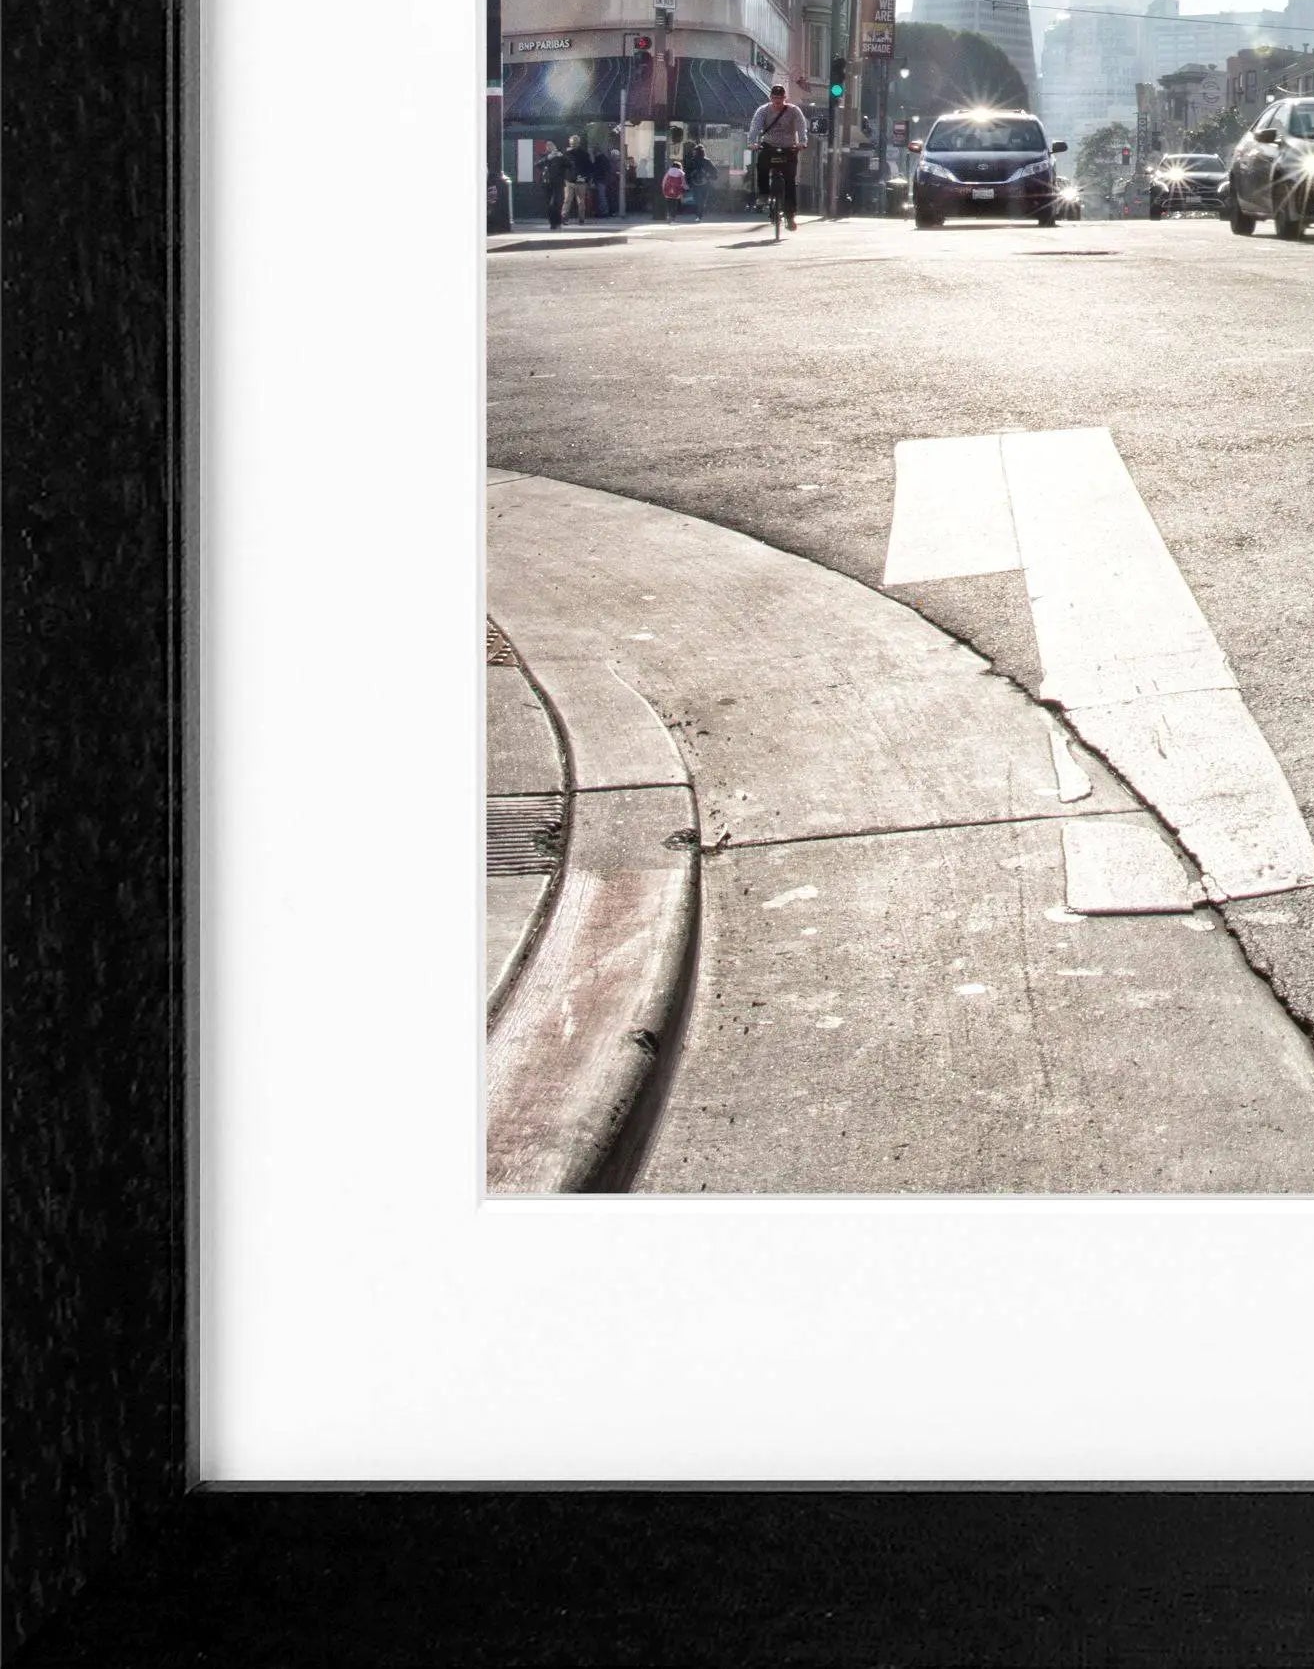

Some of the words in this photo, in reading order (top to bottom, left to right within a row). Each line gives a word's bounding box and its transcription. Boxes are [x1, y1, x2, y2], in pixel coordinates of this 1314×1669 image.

[875, 10, 893, 21] ARE
[518, 42, 535, 51] BNP
[536, 39, 570, 50] PARIBAS
